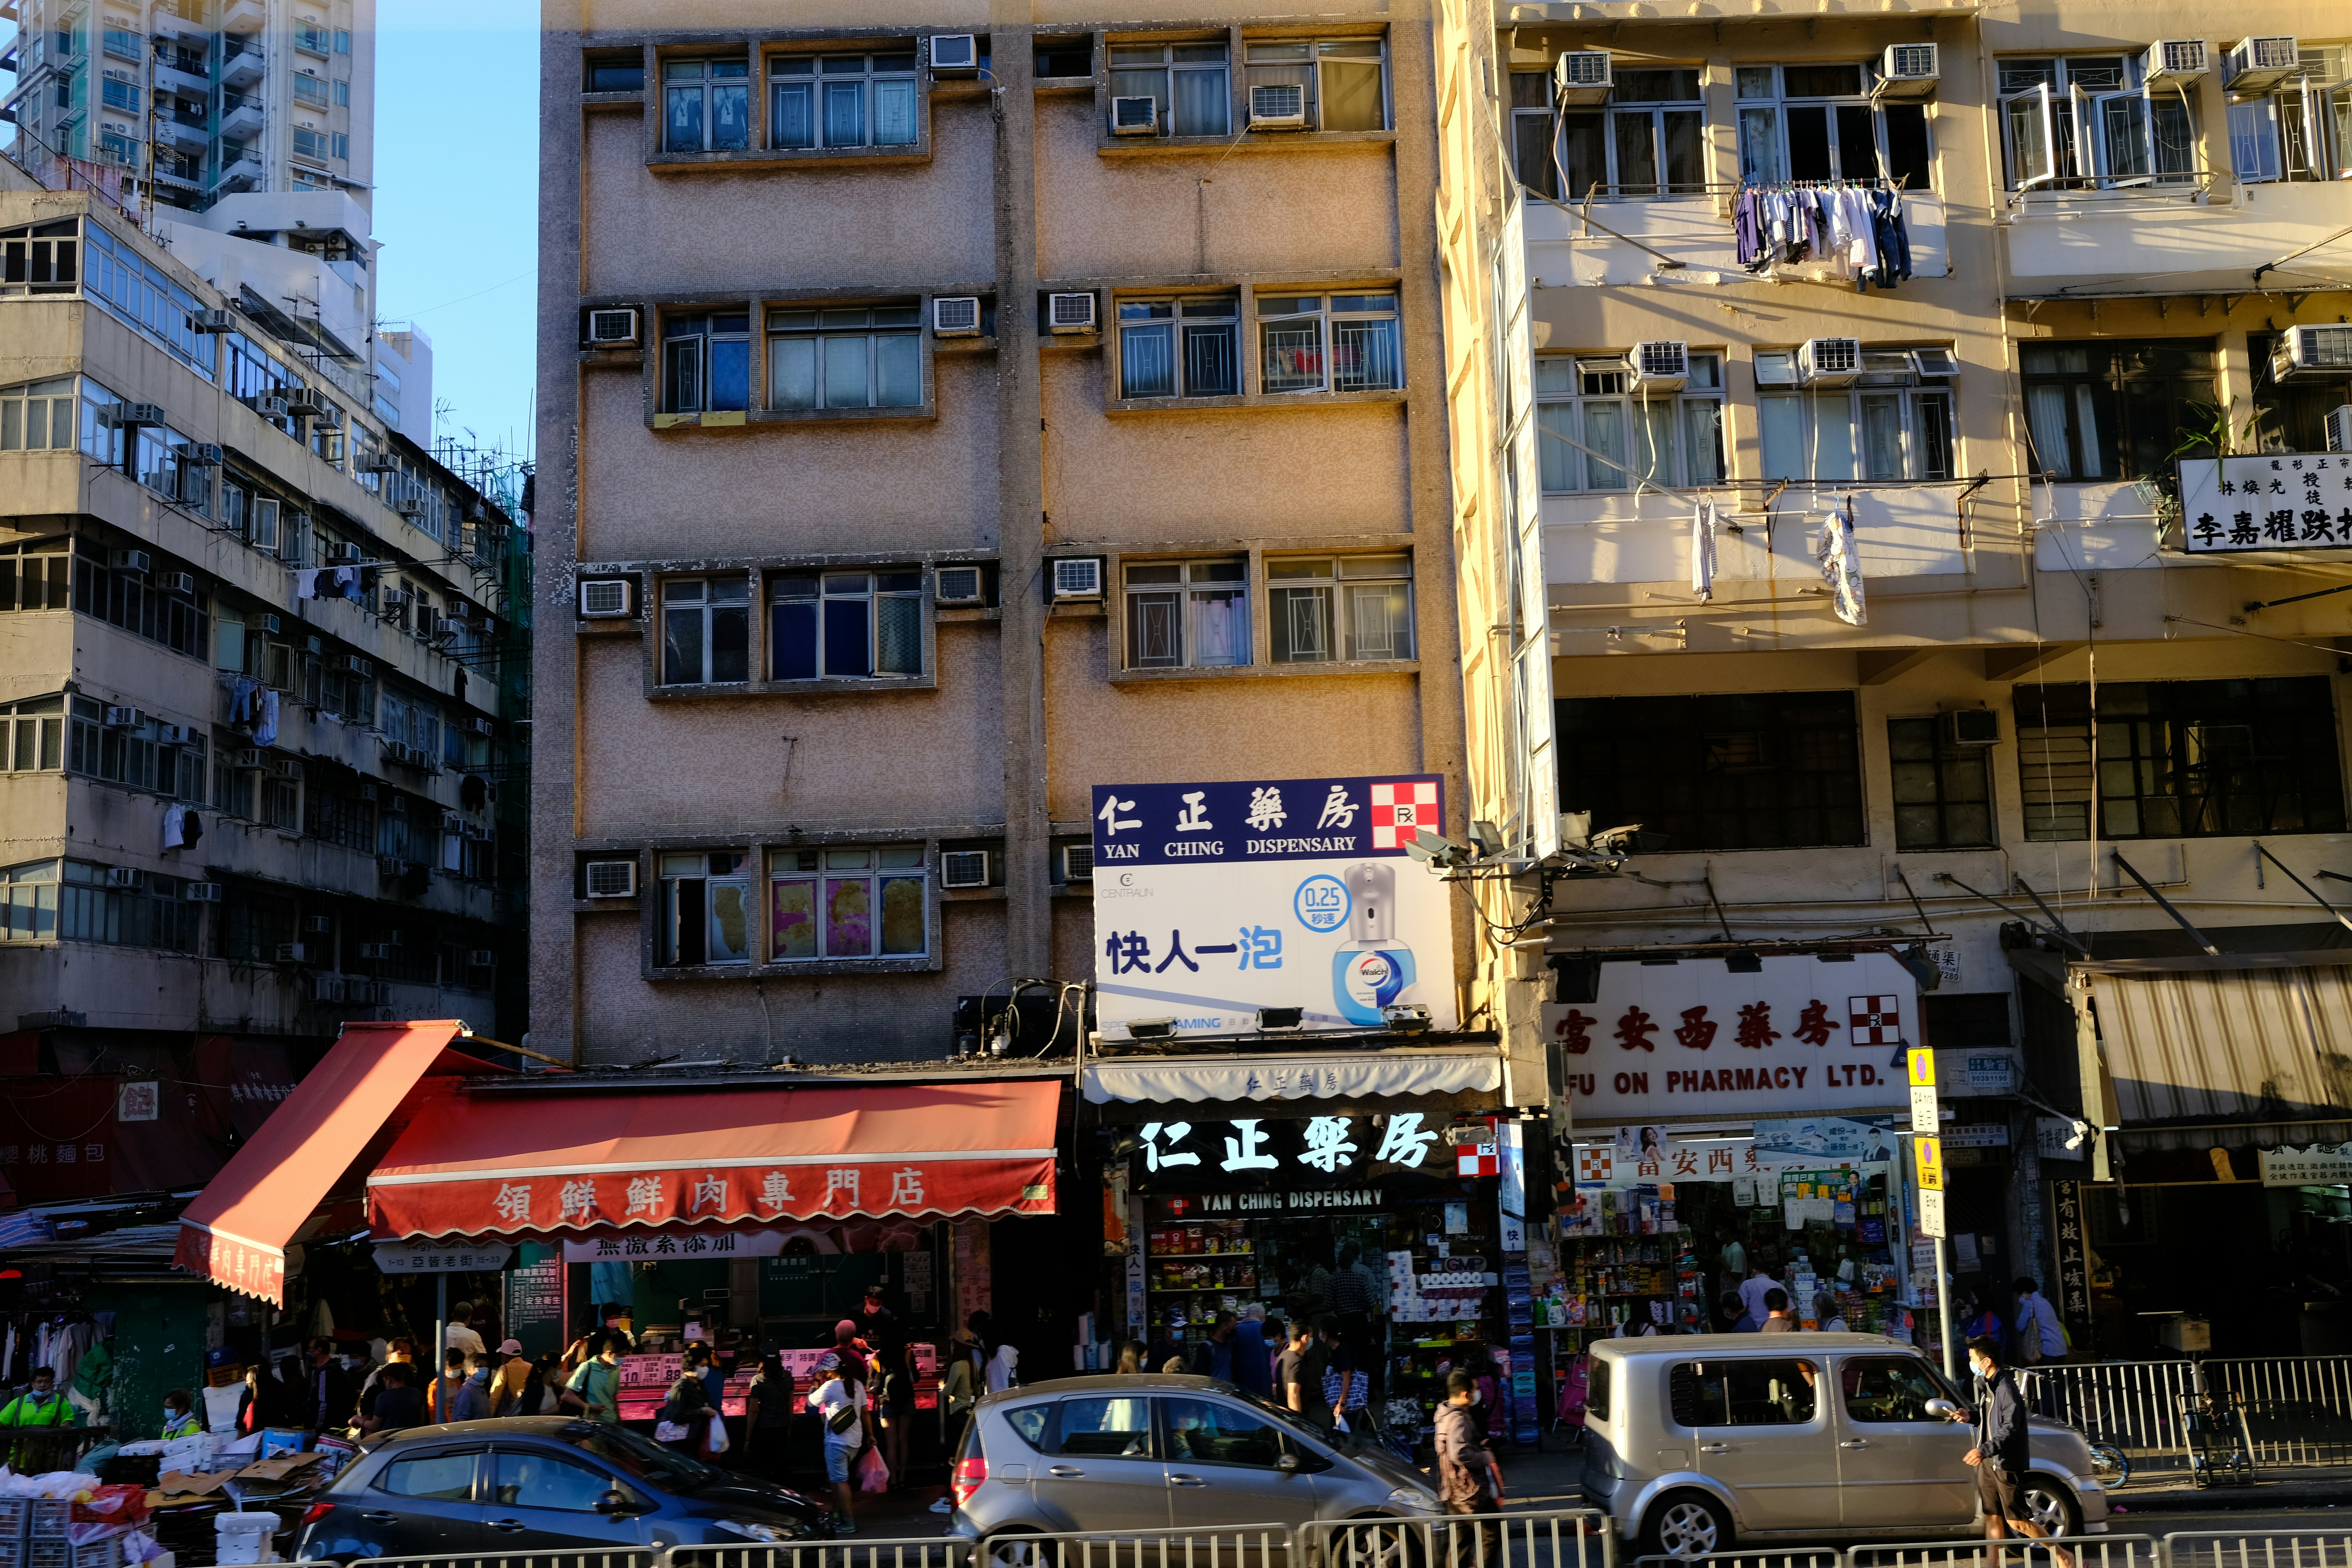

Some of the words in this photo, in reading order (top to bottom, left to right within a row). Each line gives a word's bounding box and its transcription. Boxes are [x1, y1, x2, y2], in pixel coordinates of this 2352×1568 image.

[1098, 785, 1360, 835] 仁正藥房
[1104, 844, 1139, 859] YAN
[1164, 841, 1224, 856] CHING
[1246, 836, 1357, 854] DISPENSARY
[1101, 888, 1153, 898] CENTRALIN
[1306, 887, 1340, 906] 0.25
[1311, 913, 1335, 924] 秒速
[1106, 925, 1283, 974] 快人一泡
[1929, 950, 1955, 966] 通渠
[1556, 999, 1841, 1054] 富安西藥房
[1246, 1073, 1338, 1091] 仁正藥房
[1614, 1072, 1648, 1094] ON
[1667, 1066, 1808, 1093] PHARMACY
[1827, 1064, 1884, 1087] LTD.
[1139, 1113, 1438, 1173] 仁正藥房
[0, 1144, 105, 1165] 櫻桃麵包
[492, 1167, 925, 1221] 領鮮鮮肉專門店
[1202, 1195, 1231, 1211] YAN
[1239, 1193, 1282, 1210] CHING
[1289, 1189, 1383, 1208] DISPENSARY
[597, 1233, 735, 1256] 無激素添加
[412, 1255, 473, 1268] 亞皆老街
[1447, 1258, 1484, 1271] GMP
[525, 1297, 561, 1305] 安全衛生
[666, 1369, 681, 1380] 88
